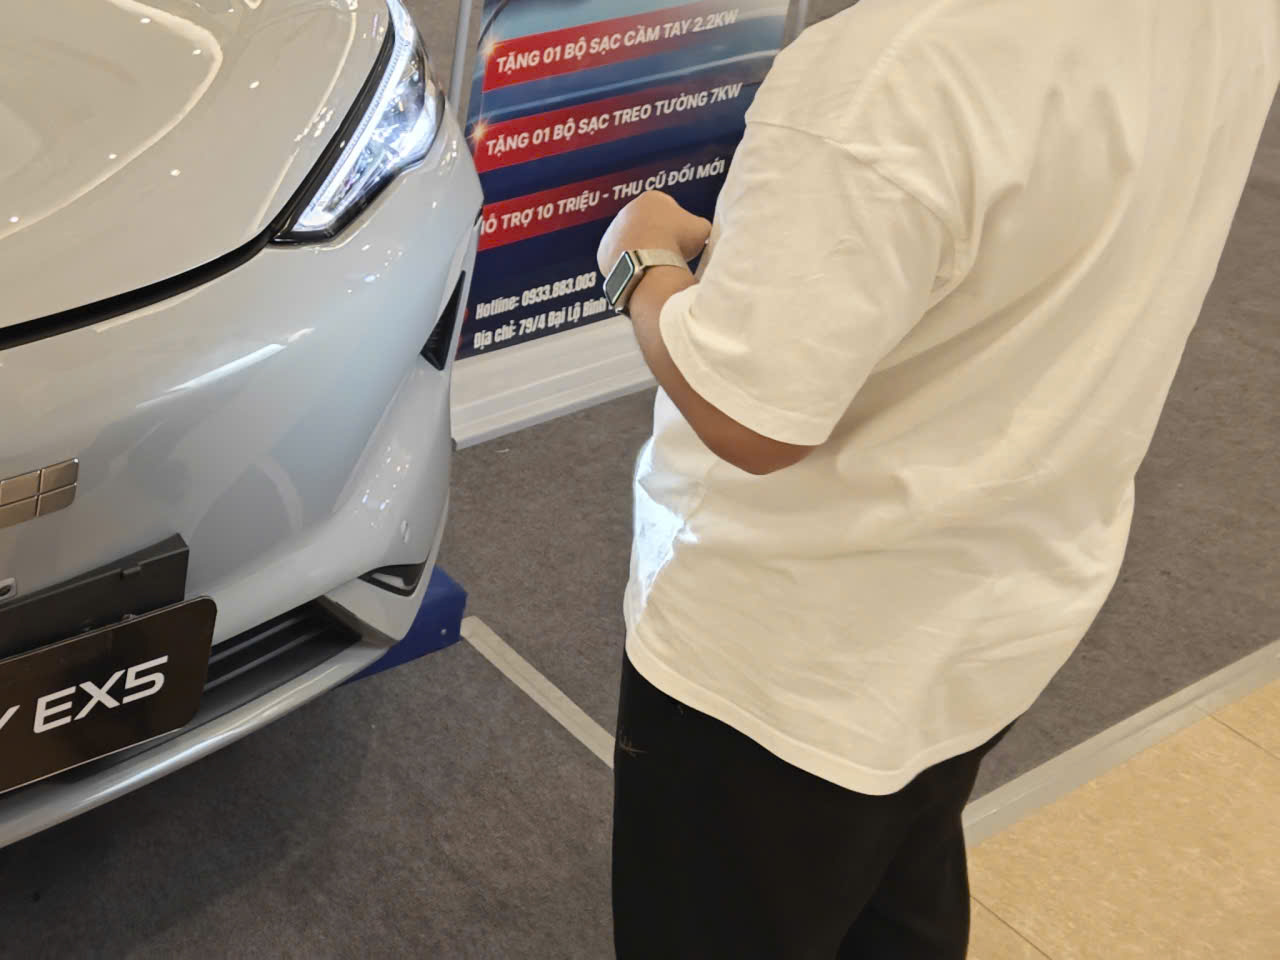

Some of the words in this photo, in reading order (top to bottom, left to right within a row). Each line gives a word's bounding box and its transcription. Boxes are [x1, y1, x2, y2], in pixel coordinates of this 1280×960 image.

[496, 50, 540, 75] TẶNG
[543, 47, 562, 65] 01
[563, 38, 588, 62] BỘ
[590, 33, 622, 55] SẠC
[624, 25, 660, 48] CẦM
[662, 19, 694, 40] TAY
[692, 8, 740, 33] 2.2KW
[486, 133, 530, 158] TẶNG
[532, 129, 551, 146] 01
[553, 119, 577, 144] BỘ
[578, 113, 610, 136] SẠC
[612, 103, 653, 126] TREO
[654, 89, 709, 117] TƯỜNG
[709, 81, 744, 105] 7KW
[500, 208, 536, 230] TRỢ
[536, 203, 554, 221] 10
[557, 190, 601, 215] TRIỆU
[612, 179, 643, 201] THU
[644, 171, 666, 191] CŨ
[666, 162, 695, 186] ĐỔI
[695, 158, 726, 180] MỚI
[473, 330, 493, 350] Địa
[518, 313, 547, 336] 79/4
[547, 307, 567, 328] Đại
[567, 302, 582, 323] Lộ
[475, 295, 520, 320] Hotline:
[33, 655, 170, 734] EX5
